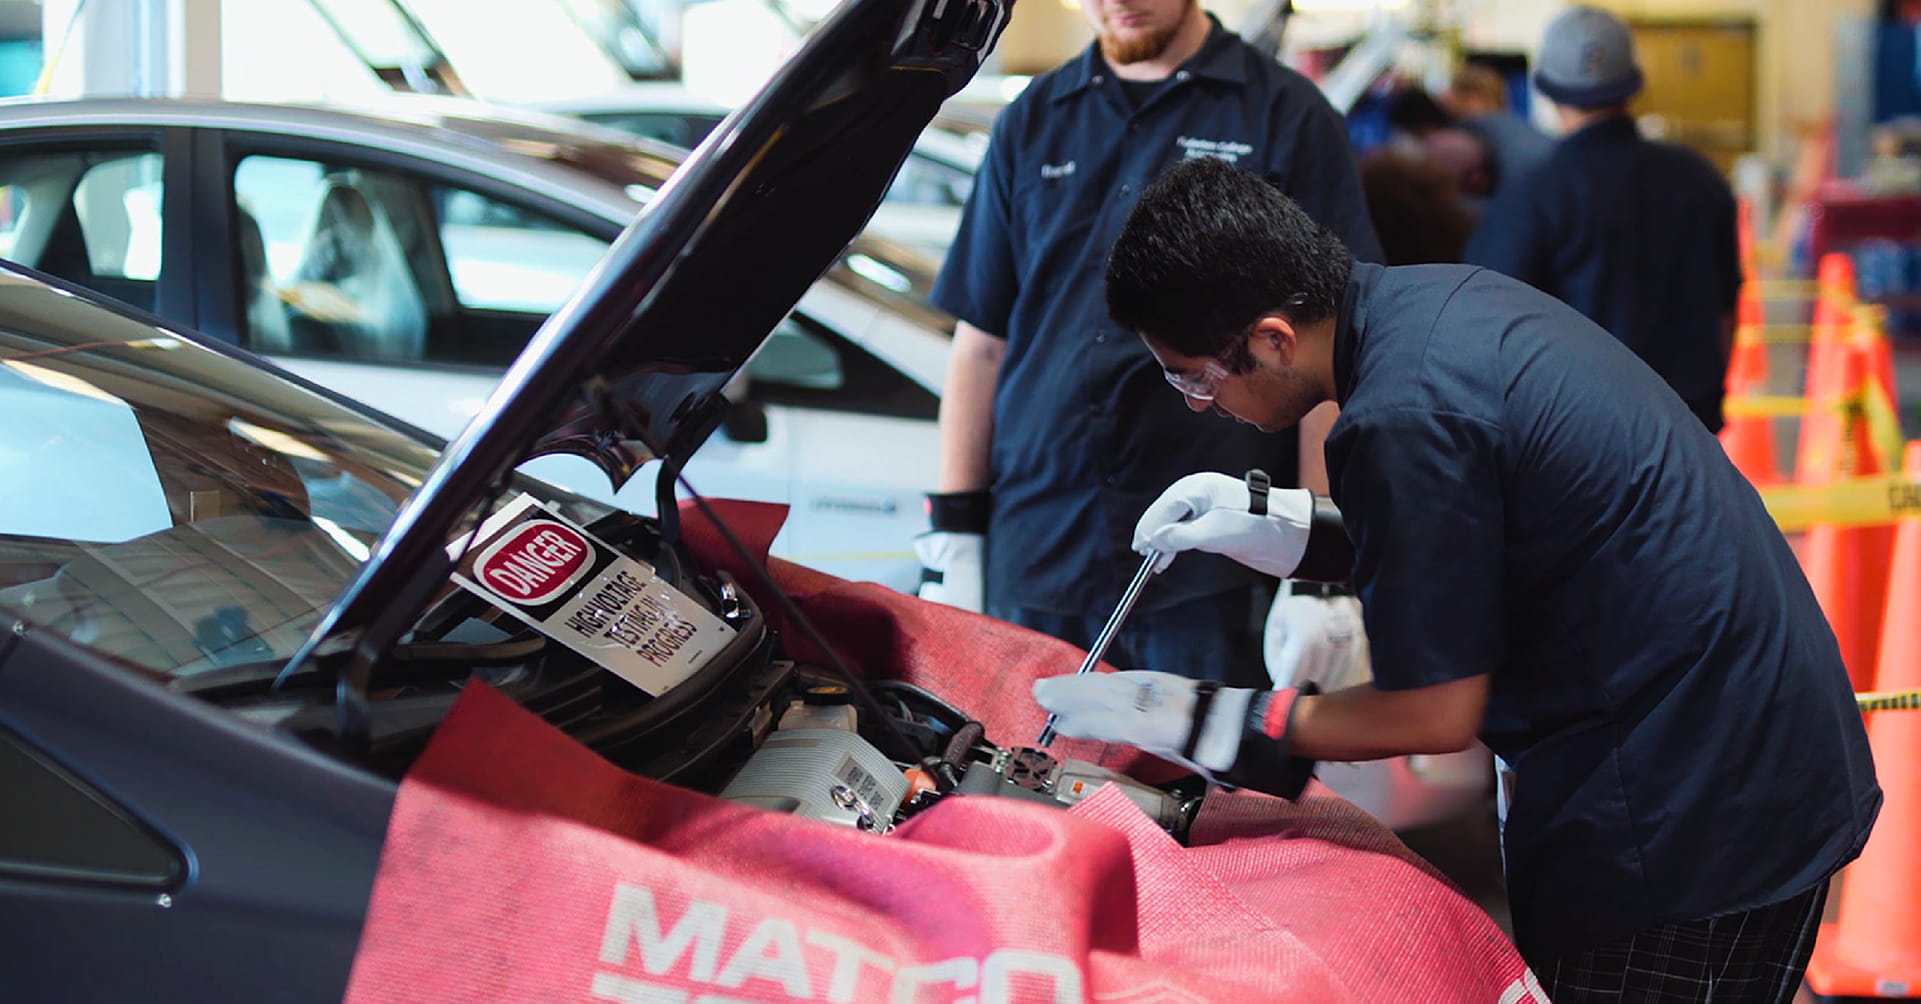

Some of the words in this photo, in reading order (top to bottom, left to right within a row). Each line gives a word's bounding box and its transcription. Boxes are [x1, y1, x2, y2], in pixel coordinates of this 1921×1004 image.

[489, 530, 582, 596] DANGER
[564, 600, 611, 639] HIGH
[591, 570, 647, 616] VOLTAGE
[602, 603, 661, 649] TESTING
[635, 620, 698, 668] PROGRESS
